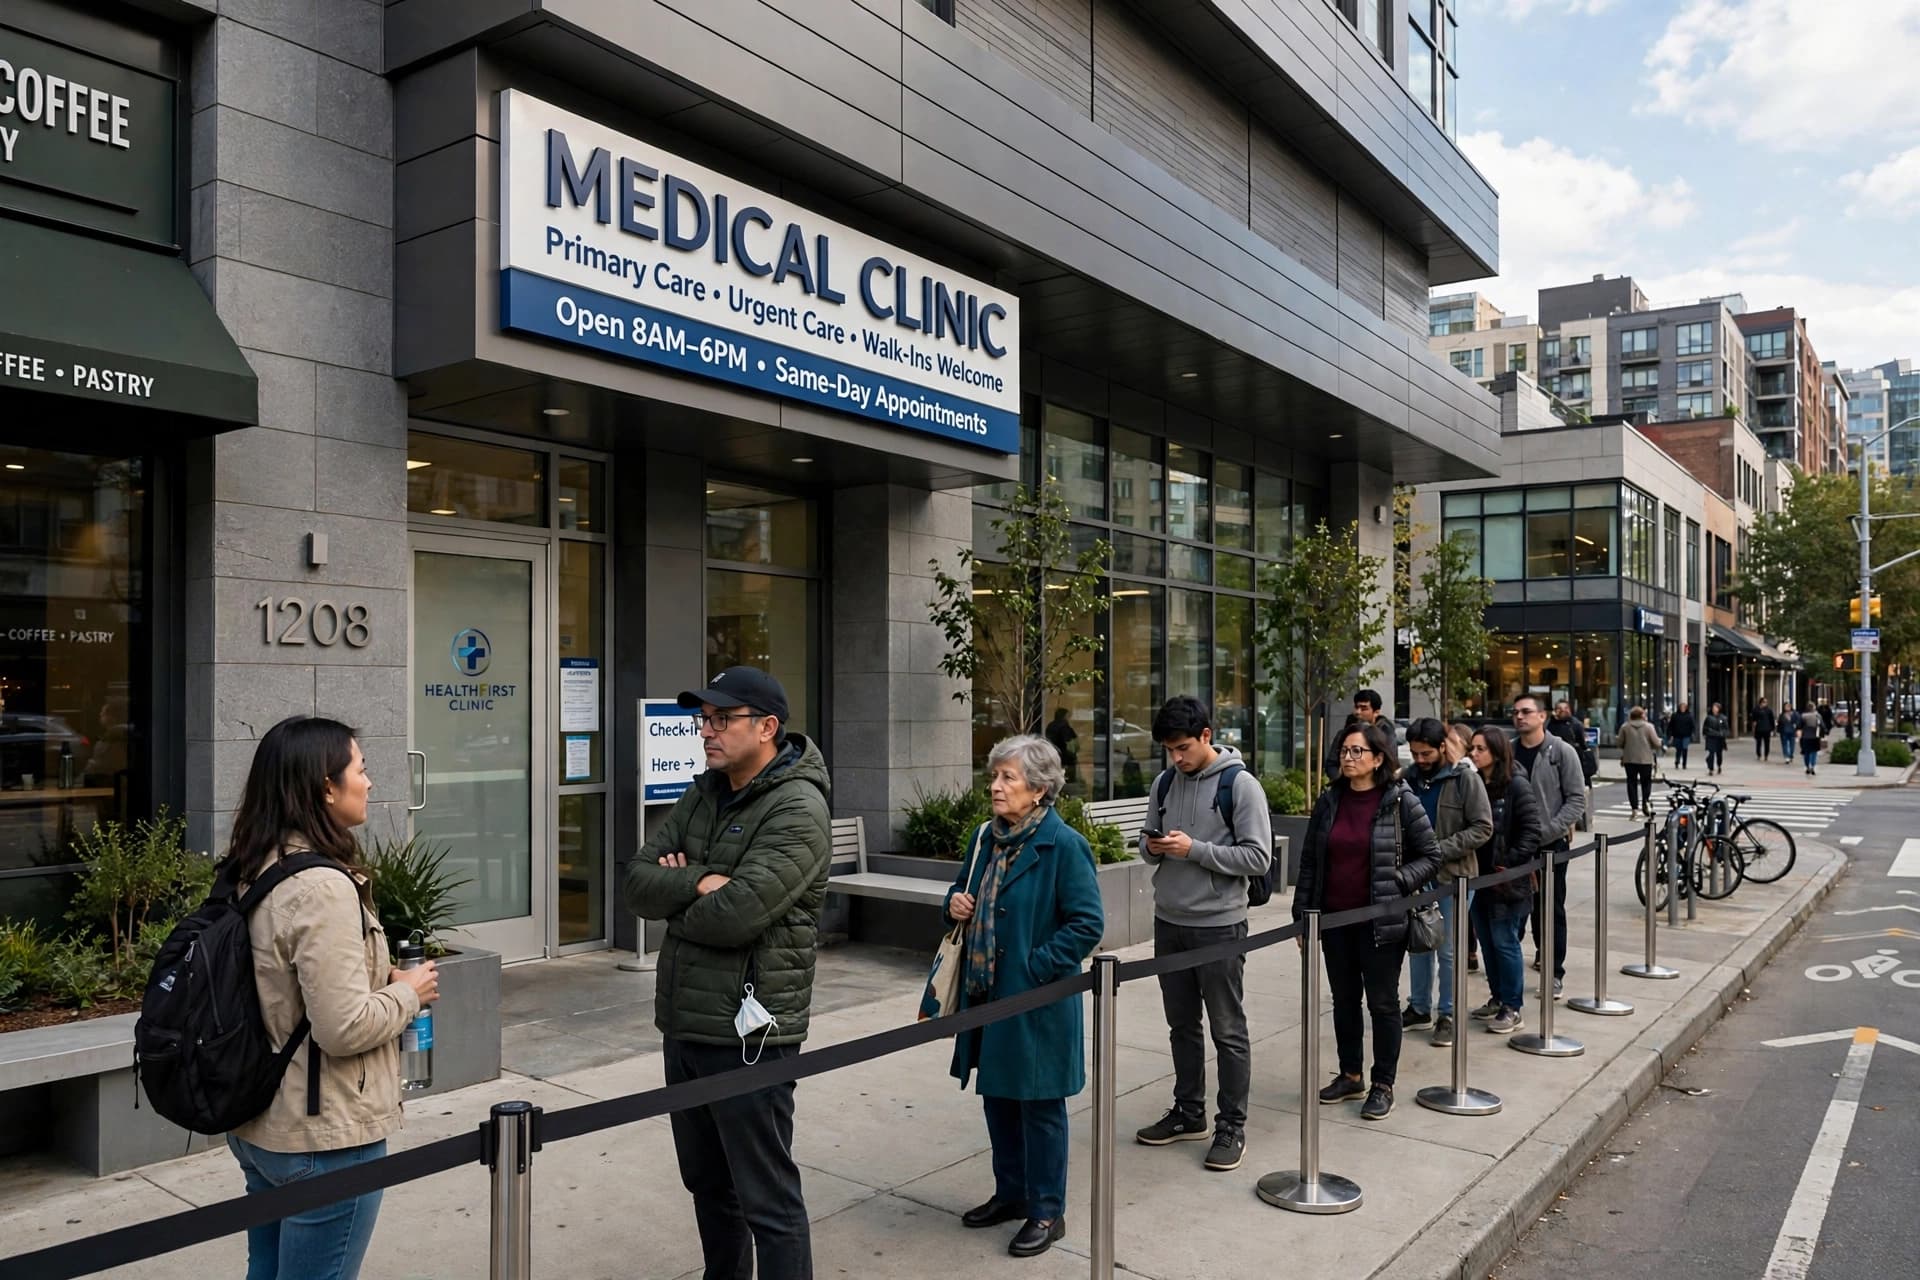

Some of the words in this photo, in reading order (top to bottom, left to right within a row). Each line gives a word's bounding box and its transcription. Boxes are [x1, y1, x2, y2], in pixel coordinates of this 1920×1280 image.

[0, 59, 130, 148] COFFEE
[546, 128, 846, 305] MEDICAL
[860, 256, 1007, 358] CLINIC
[546, 225, 647, 289] Primary
[653, 262, 706, 301] Care
[728, 285, 797, 330] Urgent
[803, 311, 845, 344] Care
[863, 328, 932, 372] Walk-Ins
[937, 352, 1003, 393] Welcome
[0, 352, 45, 381] FEE
[73, 364, 154, 398] PASTRY
[555, 296, 625, 339] Open
[775, 356, 871, 410] Same-Day
[875, 385, 988, 436] Appointments
[8, 628, 56, 641] COFFEE
[69, 629, 114, 643] PASTRY
[255, 595, 374, 648] 1208
[425, 683, 517, 698] HEALTHFIRST
[448, 699, 495, 711] CLINIC
[651, 757, 681, 773] Here
